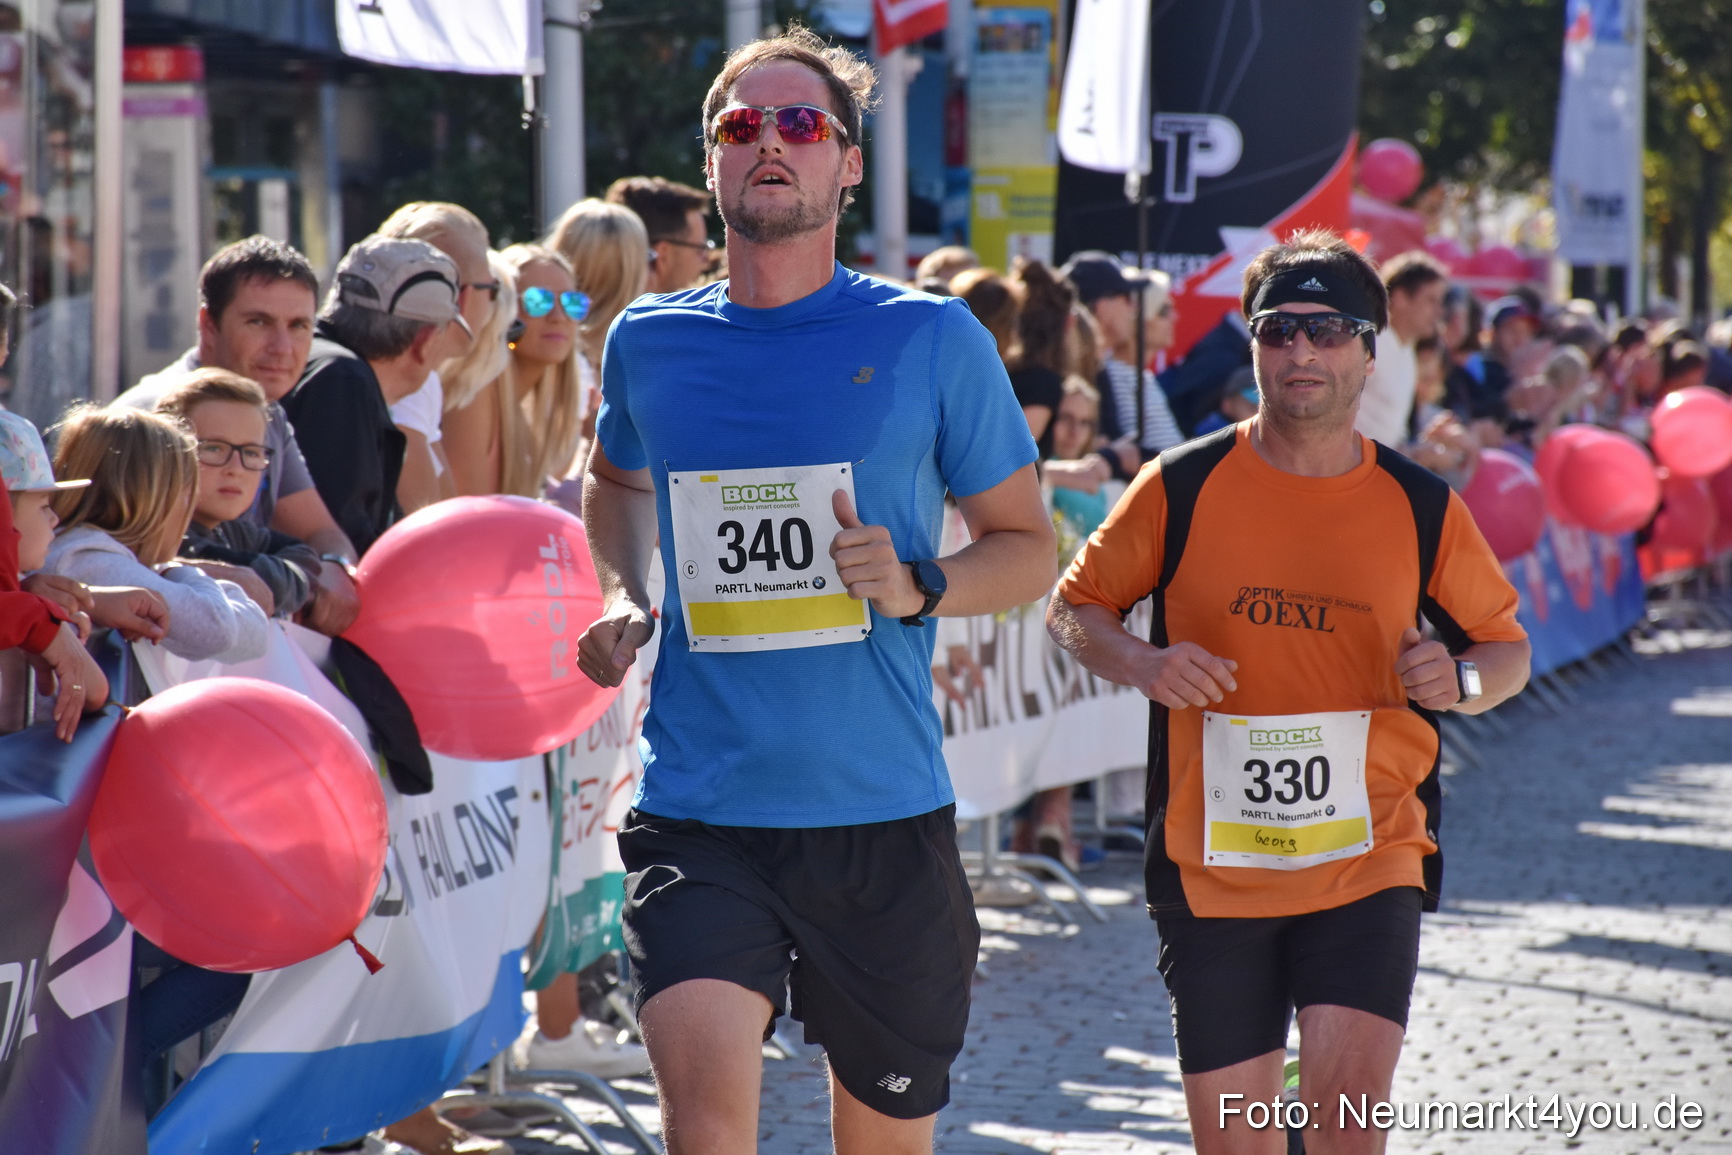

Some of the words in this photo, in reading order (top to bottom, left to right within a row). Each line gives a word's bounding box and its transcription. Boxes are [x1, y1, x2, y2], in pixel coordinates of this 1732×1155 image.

[721, 483, 799, 504] BOCK
[723, 504, 746, 512] inspired
[747, 503, 754, 511] by
[773, 502, 800, 510] concepts
[717, 517, 814, 574] 340
[715, 583, 752, 594] PARTL
[754, 580, 809, 593] Neumarkt
[1286, 592, 1313, 602] UHREN
[1315, 596, 1333, 605] UND
[1334, 599, 1373, 613] SCHMUCK
[1247, 600, 1336, 633] OEXL
[1250, 726, 1322, 746] BOCK
[1243, 755, 1331, 805] 330
[1241, 809, 1275, 821] PARTL
[1277, 809, 1322, 822] Neumarkt
[1255, 829, 1298, 852] Georg
